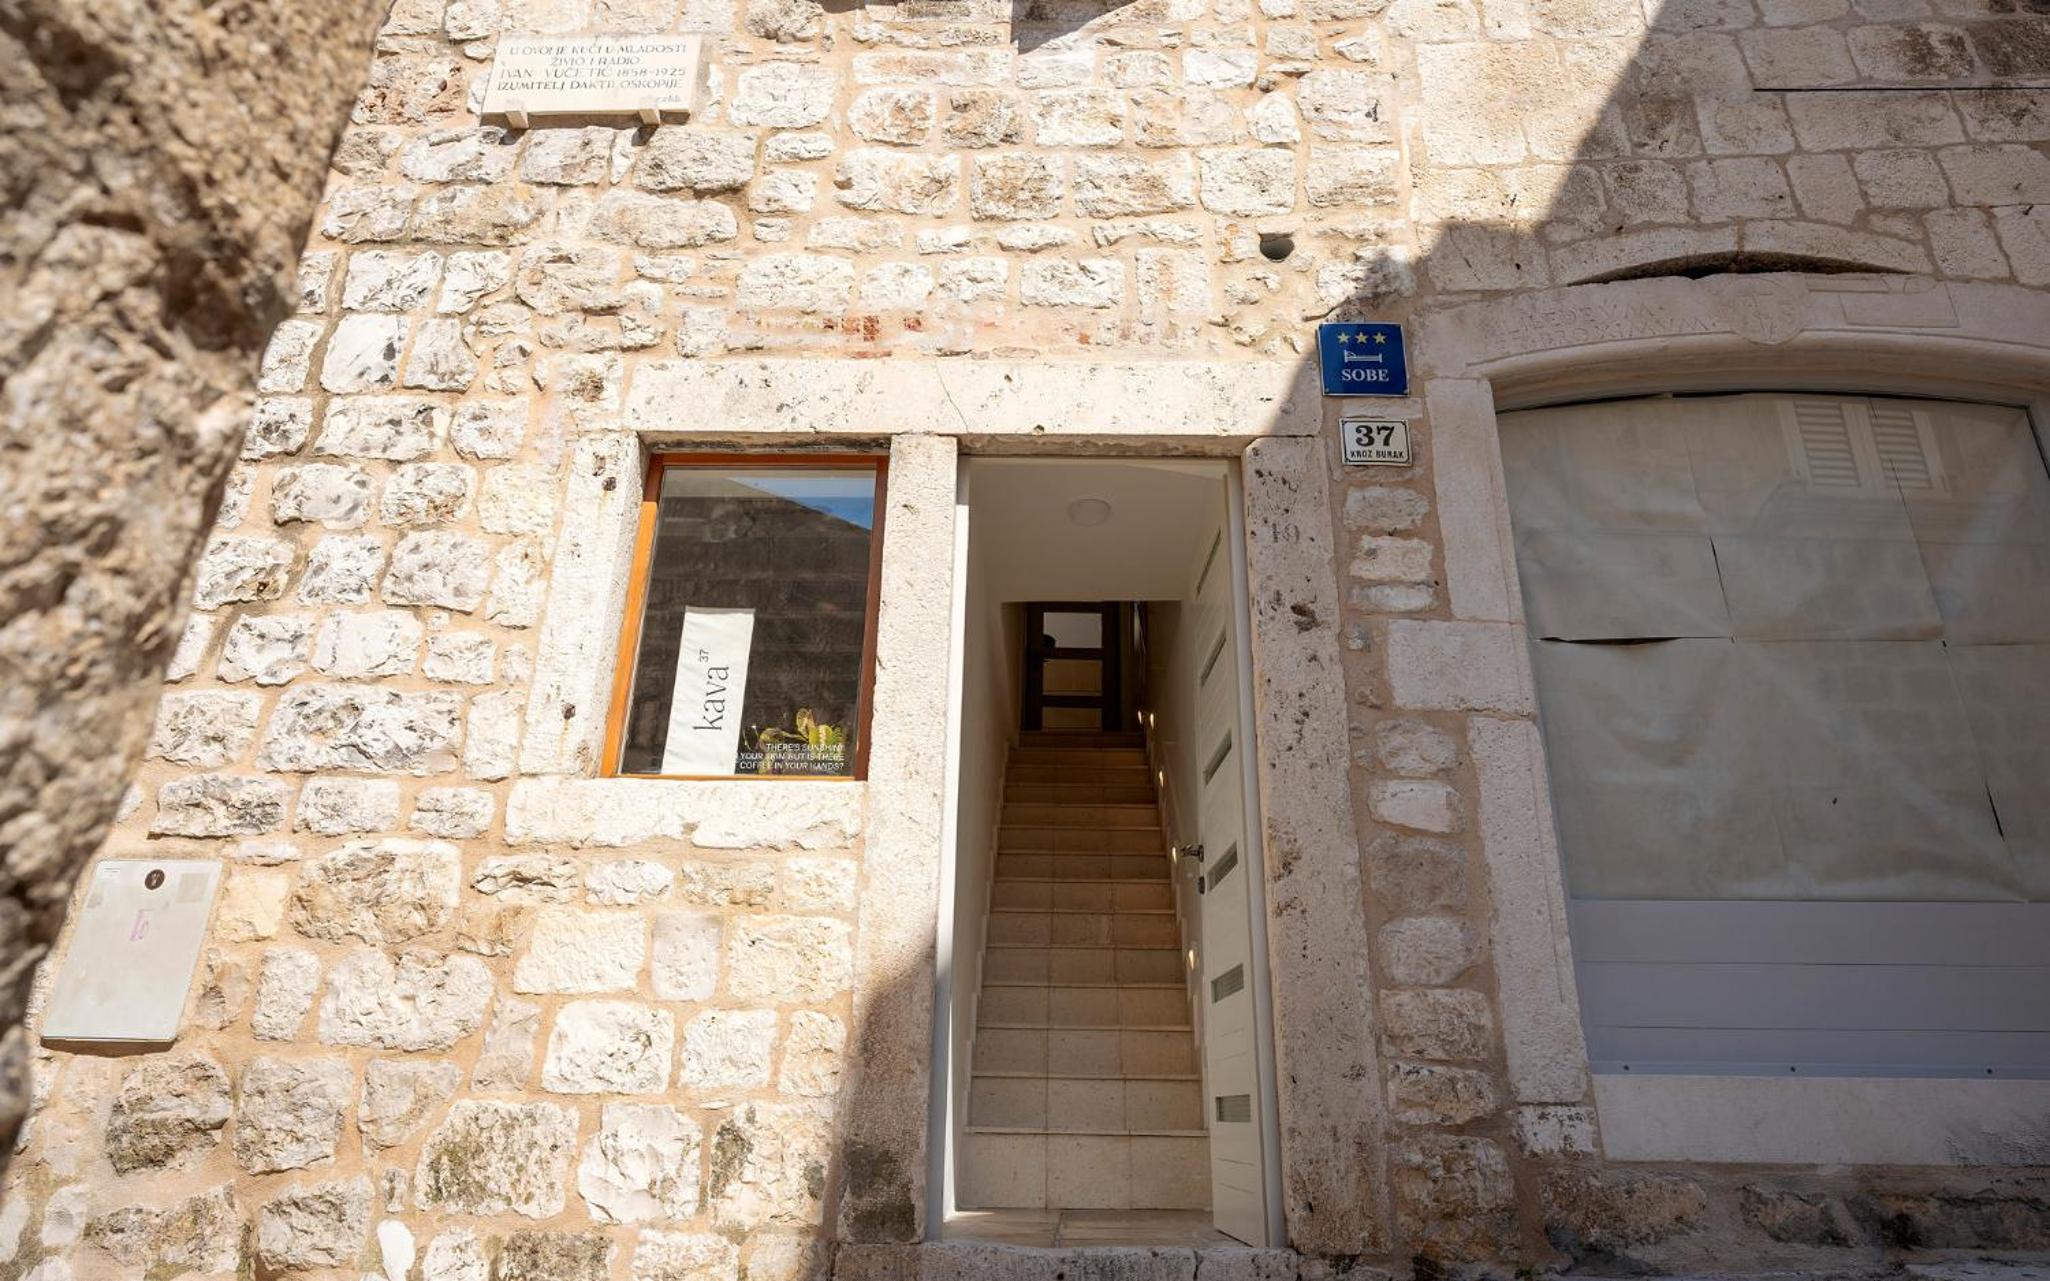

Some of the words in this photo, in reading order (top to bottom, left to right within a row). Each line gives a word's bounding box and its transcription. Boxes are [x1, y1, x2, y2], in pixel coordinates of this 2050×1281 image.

[616, 44, 686, 54] MLADOSTI
[598, 56, 641, 66] RADIO
[501, 67, 532, 78] IVAN
[497, 80, 565, 91] IZUMITELJ
[1341, 368, 1390, 383] SOBE
[1355, 425, 1395, 447] 37
[698, 648, 710, 663] 37
[692, 666, 729, 730] kava
[740, 752, 764, 760] YOUR
[774, 761, 784, 769] IN
[785, 761, 809, 769] YOUR
